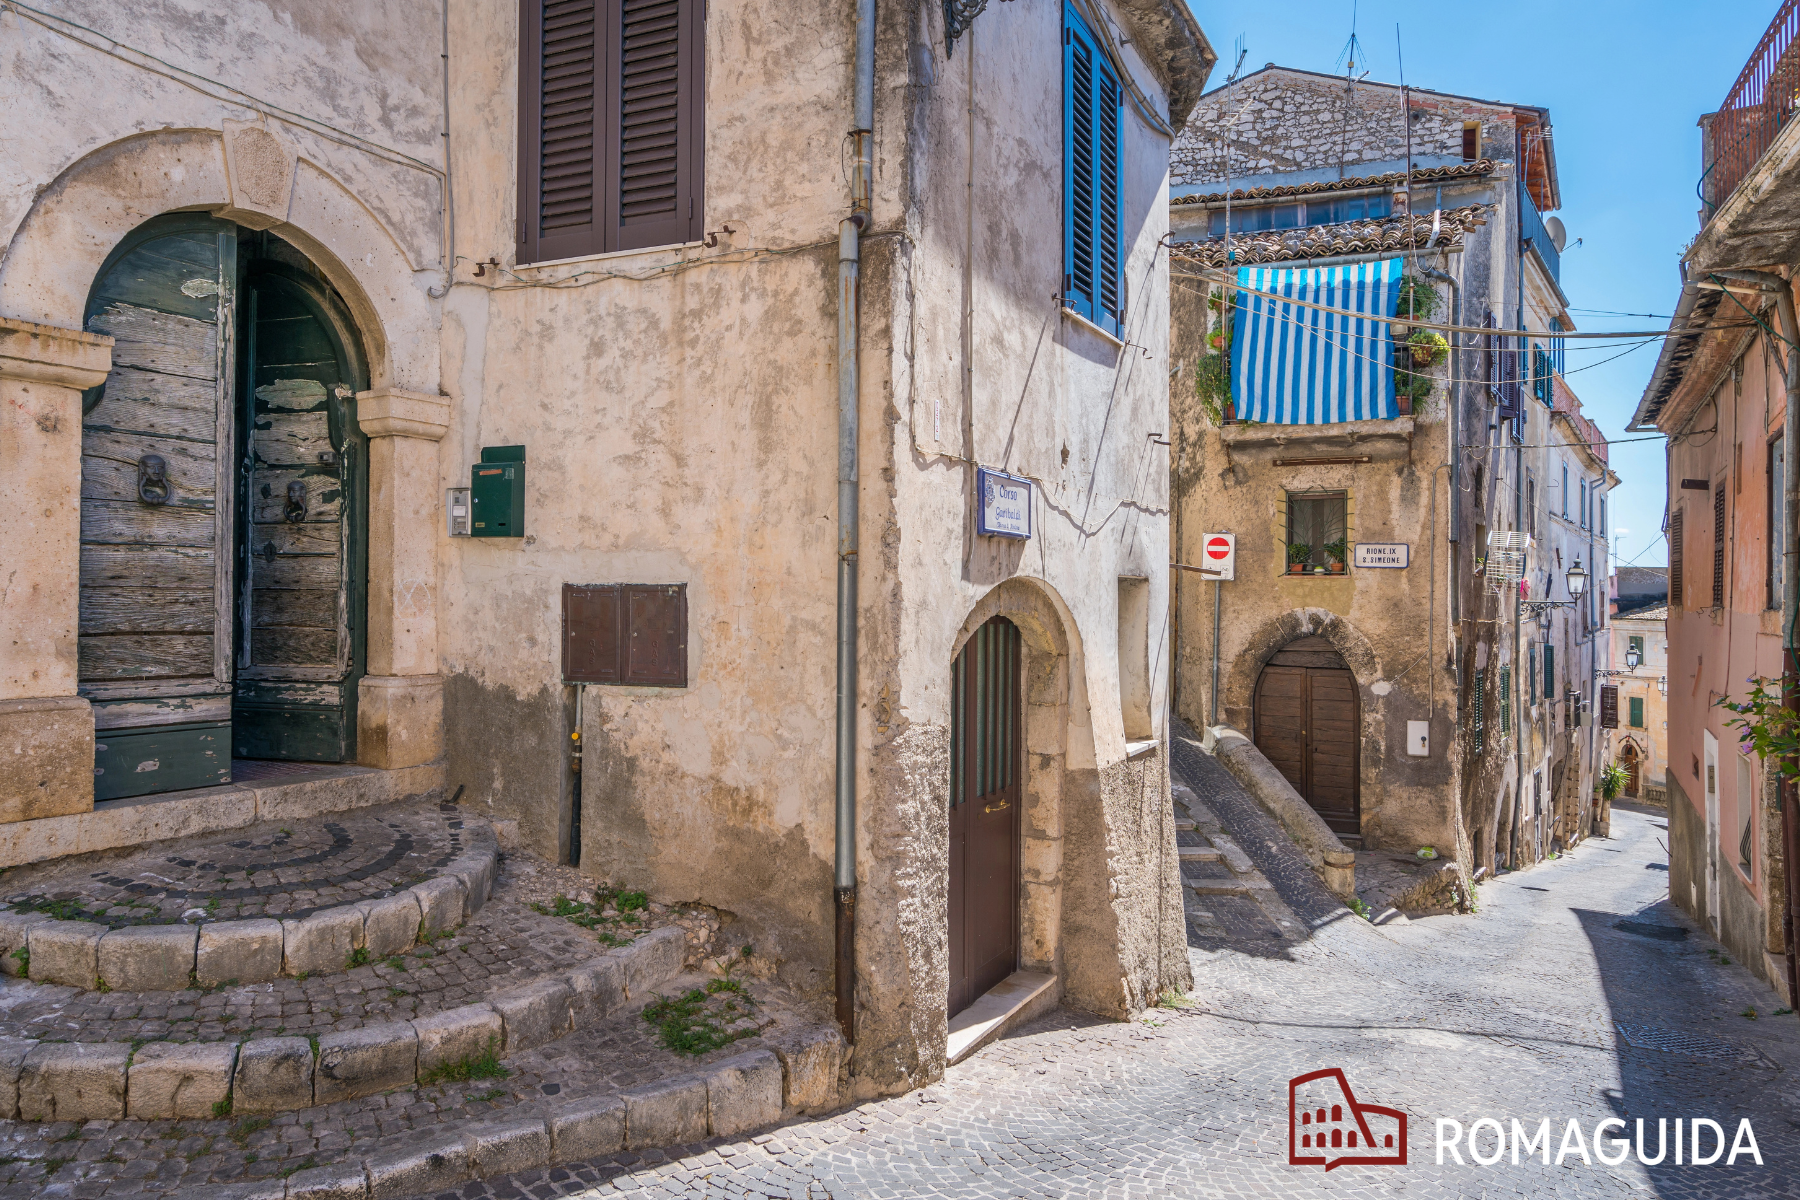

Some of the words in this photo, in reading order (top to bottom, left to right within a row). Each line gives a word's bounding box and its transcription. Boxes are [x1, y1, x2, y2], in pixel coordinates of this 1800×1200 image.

[1000, 484, 1018, 500] Corso
[588, 638, 596, 665] GAS
[651, 640, 659, 666] GAS
